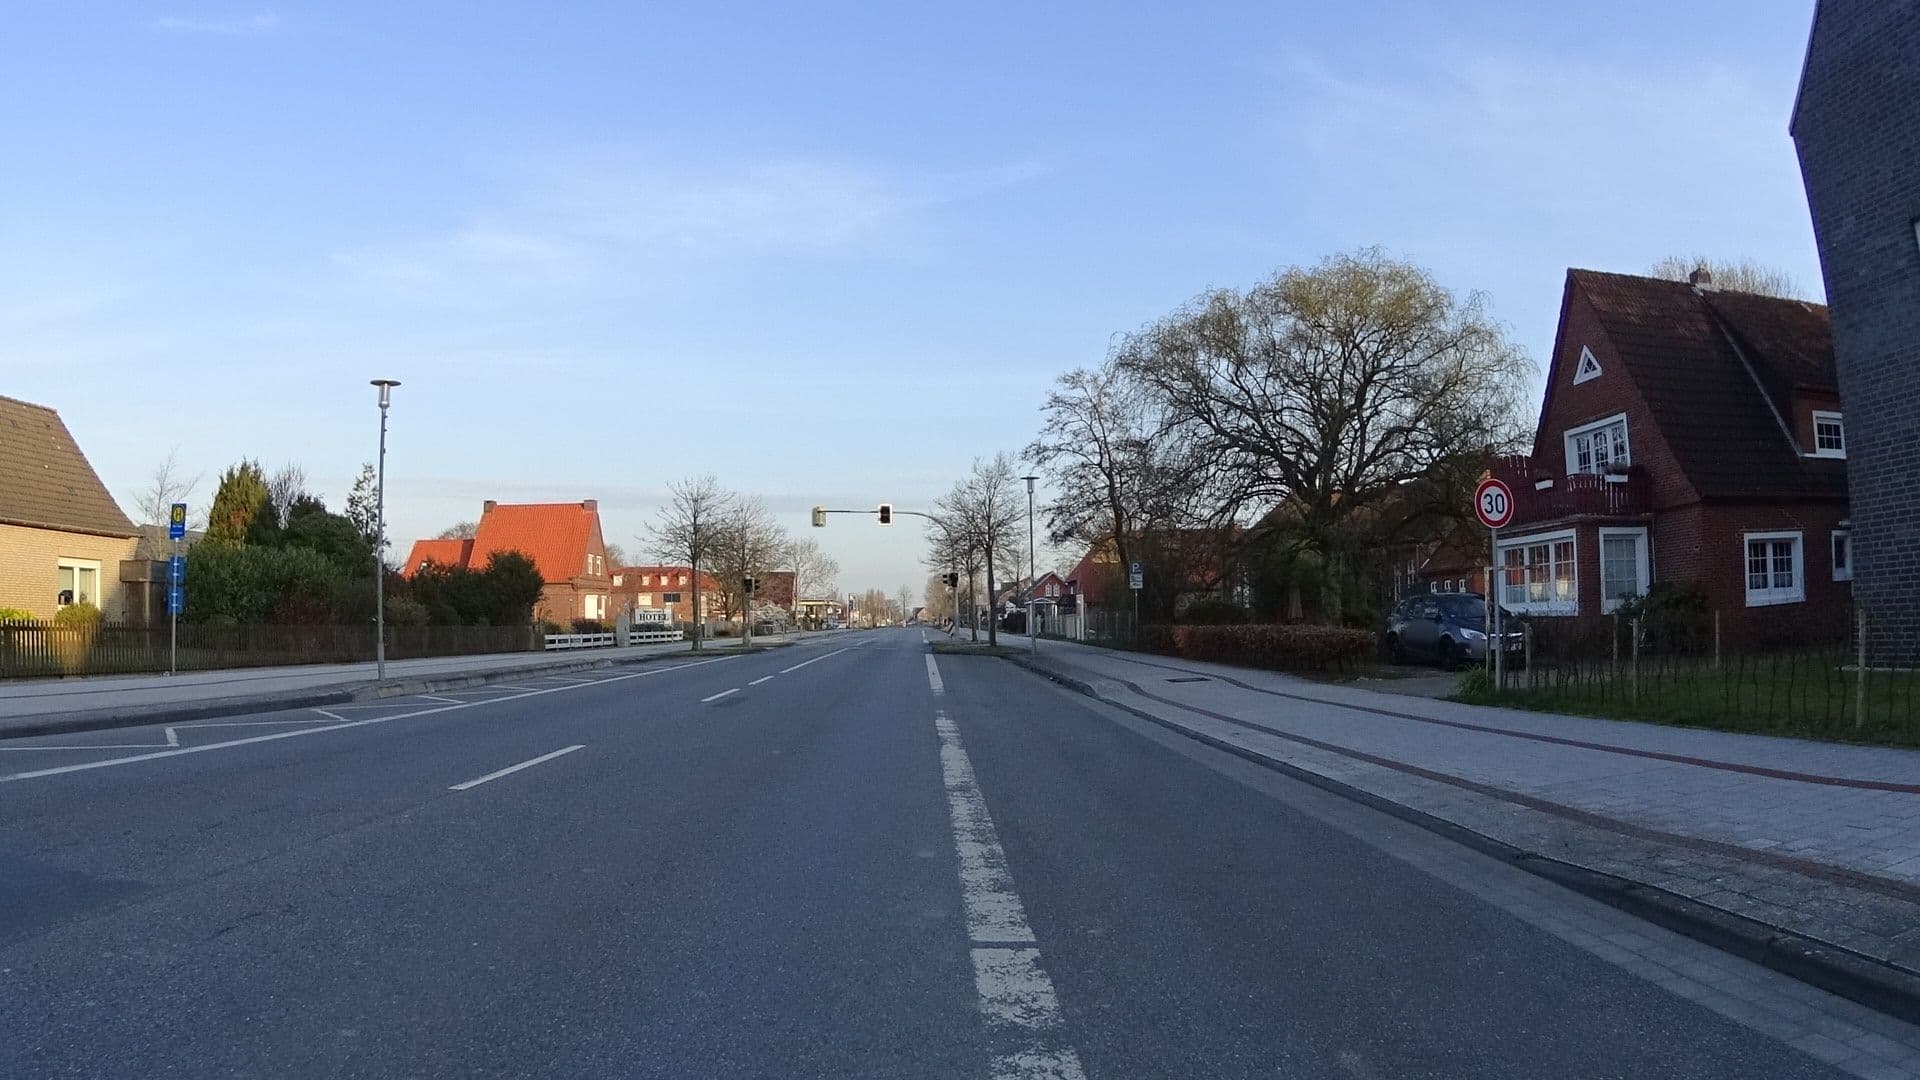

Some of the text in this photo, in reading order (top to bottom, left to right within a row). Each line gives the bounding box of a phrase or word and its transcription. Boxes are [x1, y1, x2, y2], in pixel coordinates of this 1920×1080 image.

[1484, 493, 1505, 514] 30
[175, 509, 181, 520] H
[1132, 562, 1139, 573] P
[640, 613, 667, 621] HOTEL
